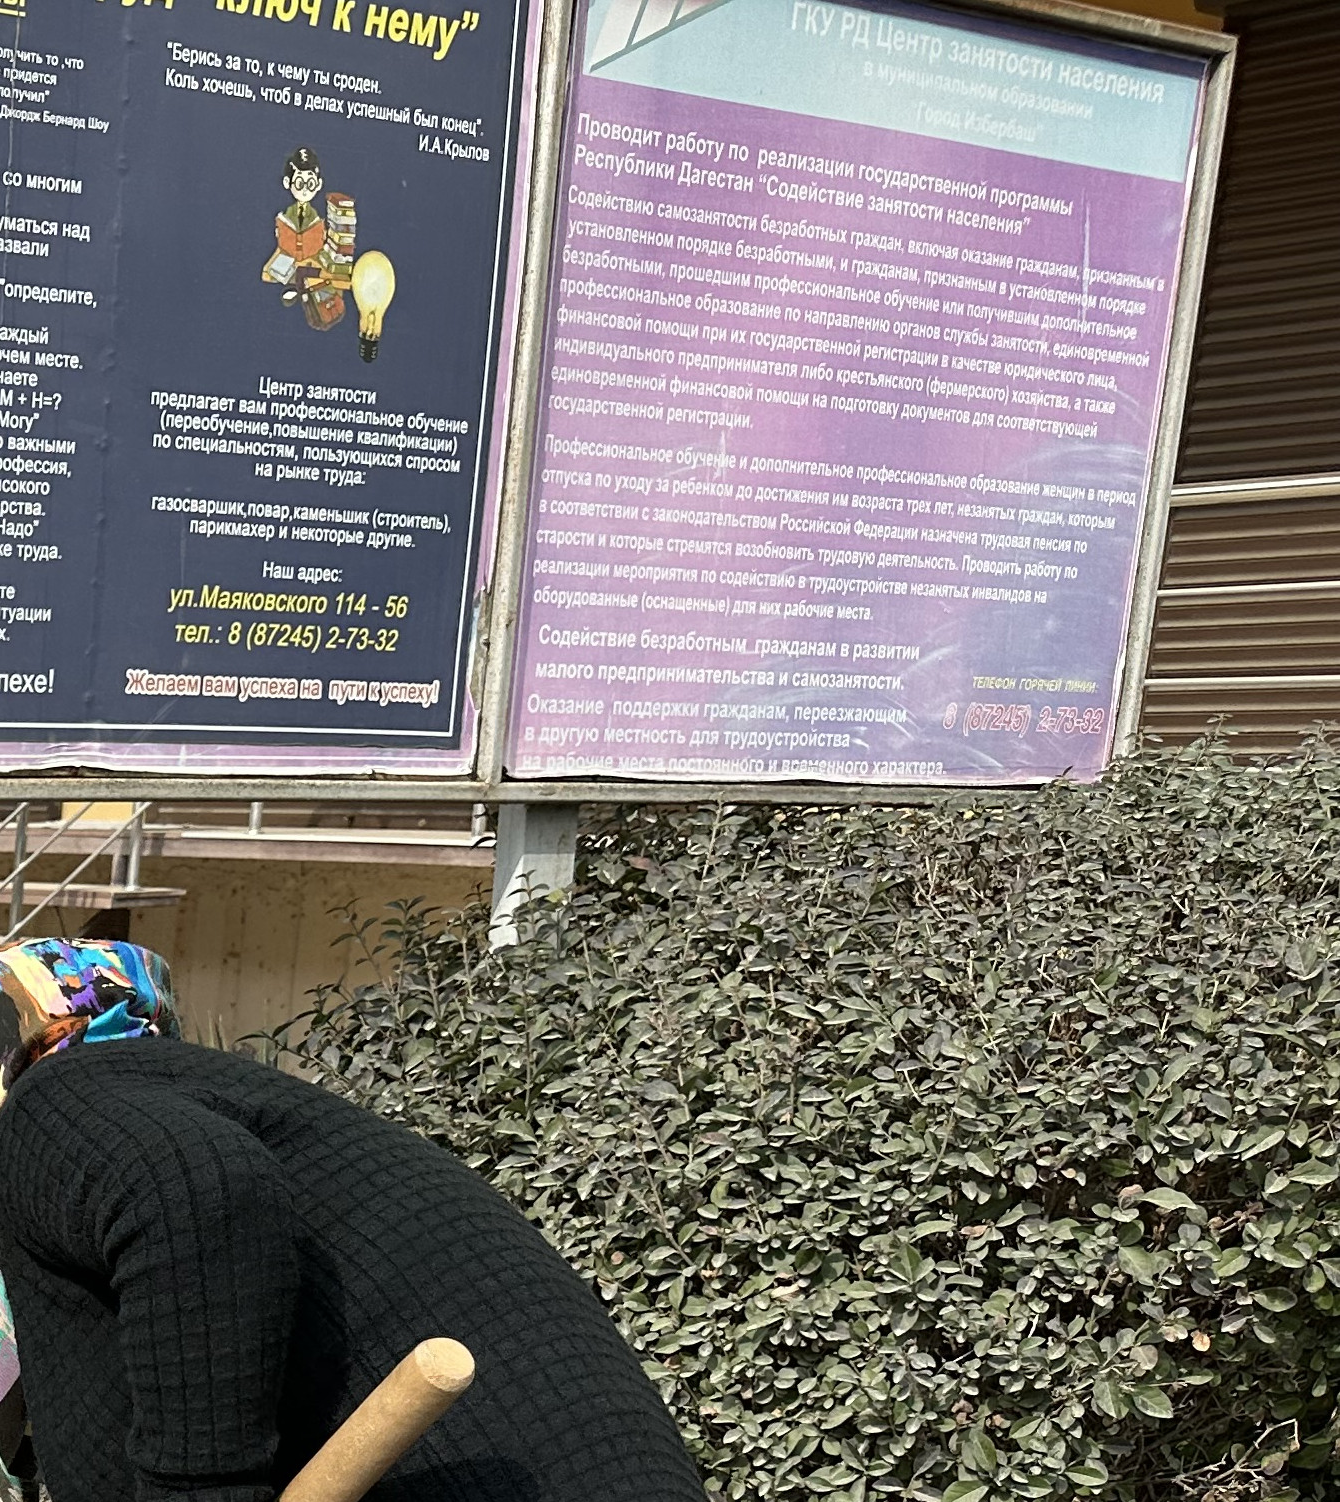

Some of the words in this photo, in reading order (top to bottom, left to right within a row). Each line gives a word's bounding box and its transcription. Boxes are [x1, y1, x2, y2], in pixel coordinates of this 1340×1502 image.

[3, 68, 56, 85] придется
[45, 54, 58, 66] то
[61, 58, 83, 69] ,что
[226, 55, 241, 70] за
[245, 58, 262, 77] то,
[267, 62, 274, 76] к
[278, 64, 310, 85] чему
[313, 70, 329, 84] ты
[333, 73, 381, 94] сроден.
[0, 104, 40, 122] Джордж
[43, 110, 85, 129] Бернард
[88, 117, 109, 133] Шоу
[419, 134, 489, 161] И.А.Крылов
[577, 113, 662, 148] Проводит
[665, 132, 724, 162] работу
[729, 144, 748, 161] по
[757, 149, 854, 178] реализации
[859, 164, 986, 200] государственной
[990, 188, 1073, 215] программы
[259, 376, 303, 400] Центр
[307, 385, 376, 404] занятости
[263, 561, 294, 579] Наш
[297, 567, 342, 584] адрес:
[167, 585, 327, 613] ул.Маяковского
[336, 592, 366, 615] 114
[385, 596, 408, 617] 56
[175, 624, 222, 643] тел.:
[228, 622, 241, 644] 8
[247, 622, 321, 653] (87245)
[325, 626, 398, 650] 2-73-32
[539, 624, 636, 648] Содействие
[641, 629, 746, 653] безработным
[753, 638, 836, 659] гражданам
[840, 642, 848, 656] в
[853, 644, 920, 662] развитии
[125, 668, 201, 695] Желаем
[202, 675, 238, 696] вам
[238, 676, 298, 702] успеха
[299, 679, 322, 699] на
[328, 680, 367, 705] пути
[368, 685, 380, 701] к
[380, 684, 439, 708] успеху!
[535, 663, 593, 679] малого
[598, 665, 774, 686] предпринимательства
[779, 672, 788, 685] и
[792, 672, 903, 690] самозанятости.
[943, 702, 957, 730] 8
[962, 702, 1031, 738] (87245)
[1036, 705, 1105, 734] 2-73-32
